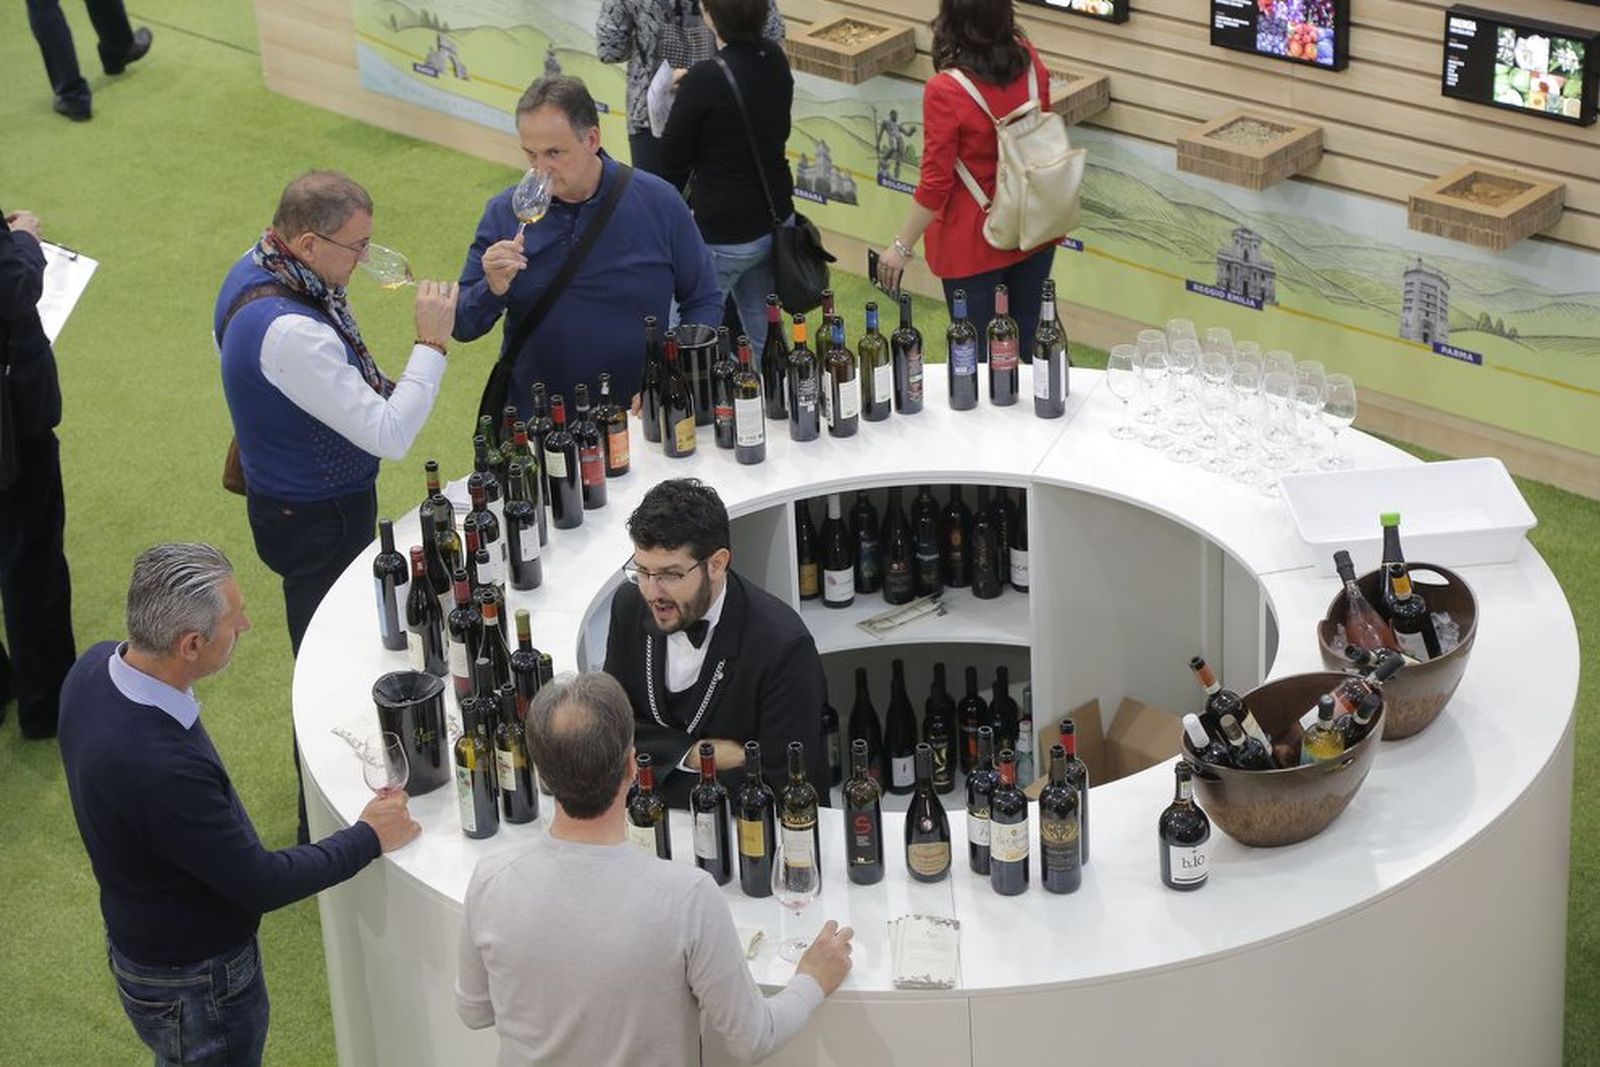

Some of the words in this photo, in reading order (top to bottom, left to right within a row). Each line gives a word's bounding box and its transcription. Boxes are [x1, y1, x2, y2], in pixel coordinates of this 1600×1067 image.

[793, 188, 823, 203] ERRARA
[1193, 284, 1226, 299] REGGIO
[1227, 291, 1257, 308] EMILIA
[1441, 345, 1473, 362] PARMA
